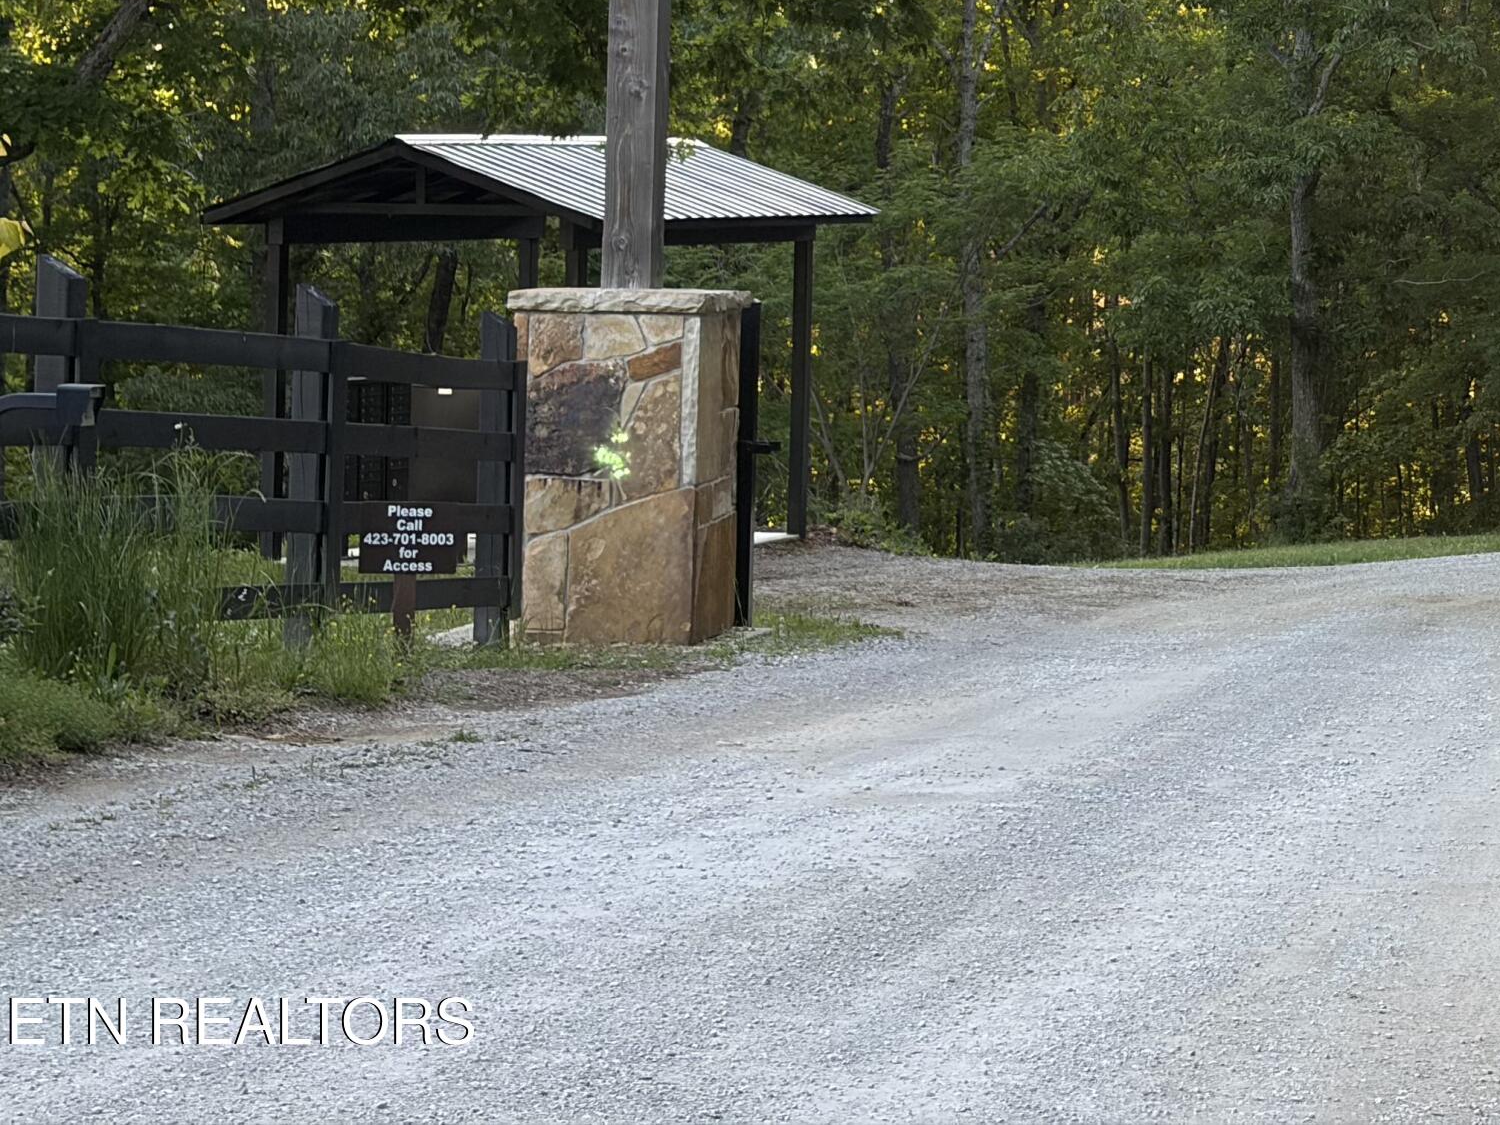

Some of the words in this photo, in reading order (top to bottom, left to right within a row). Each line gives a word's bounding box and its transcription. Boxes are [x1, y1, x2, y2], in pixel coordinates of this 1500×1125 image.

[387, 505, 433, 517] Please
[396, 519, 423, 531] Call
[363, 533, 455, 545] 423-701-8003
[398, 547, 419, 559] for
[382, 559, 433, 572] Access
